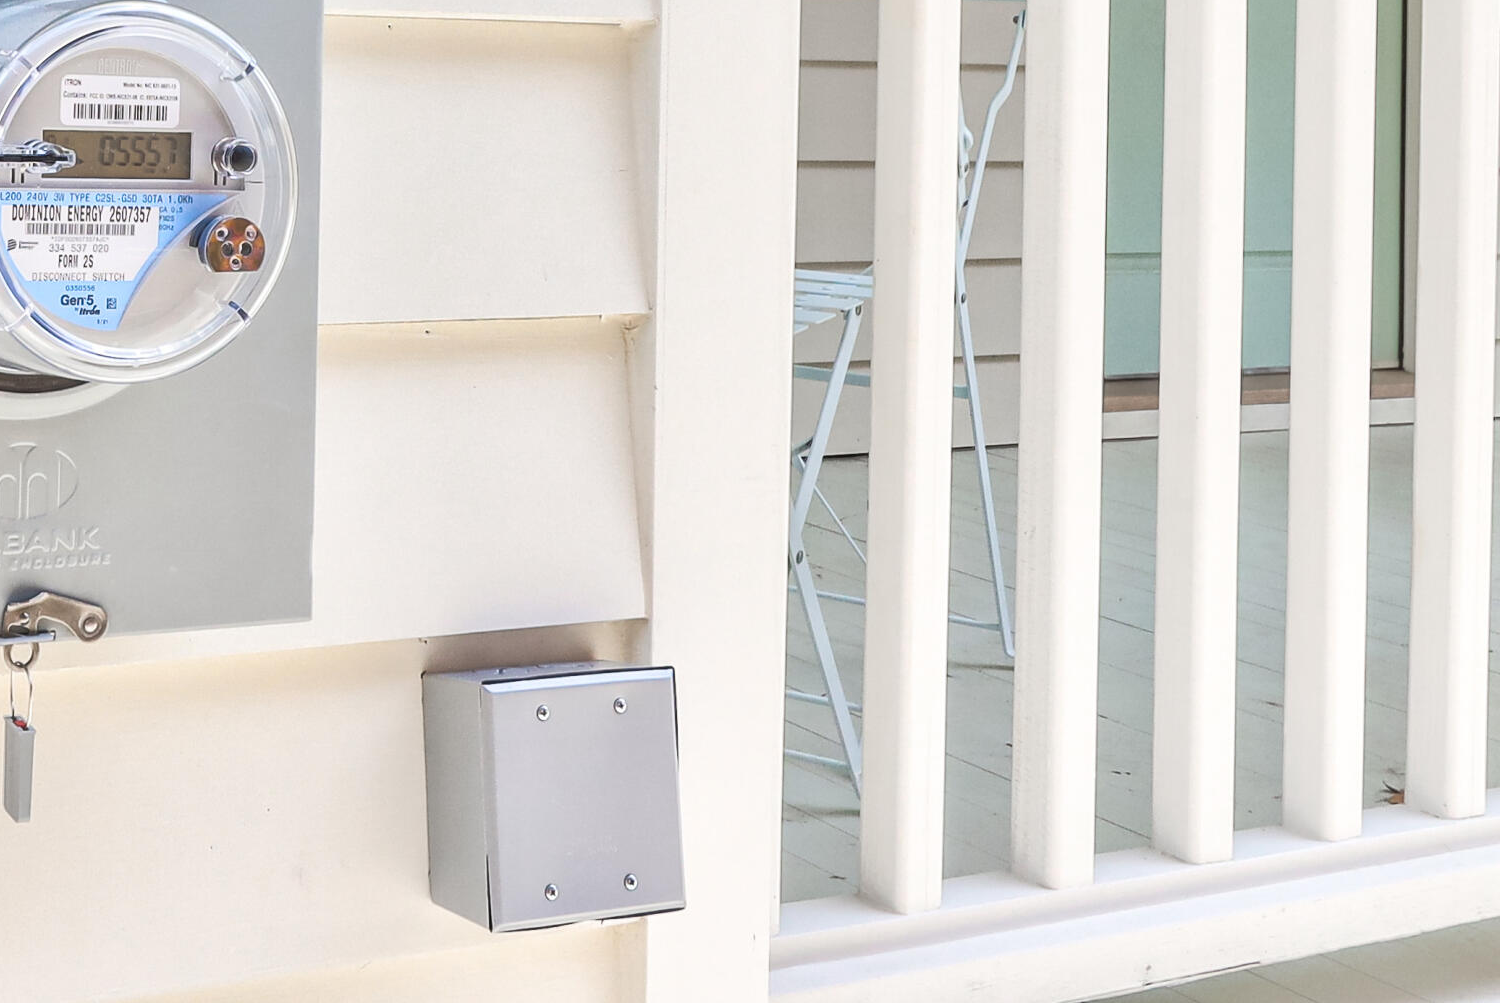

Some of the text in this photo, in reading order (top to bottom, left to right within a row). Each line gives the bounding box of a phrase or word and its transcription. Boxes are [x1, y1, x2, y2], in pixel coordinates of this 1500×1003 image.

[27, 192, 48, 201] 240V
[54, 193, 64, 201] 3W
[70, 193, 89, 202] TYPE
[143, 195, 163, 203] 30TA
[12, 204, 151, 222] DOMINION ENERGY 2607357
[49, 244, 108, 252] 334 537 020
[58, 255, 94, 267] FORM 2S
[32, 272, 124, 281] DISCONNECT SWITCH
[61, 295, 94, 305] Gen 5
[12, 554, 111, 571] ENCLOSURE
